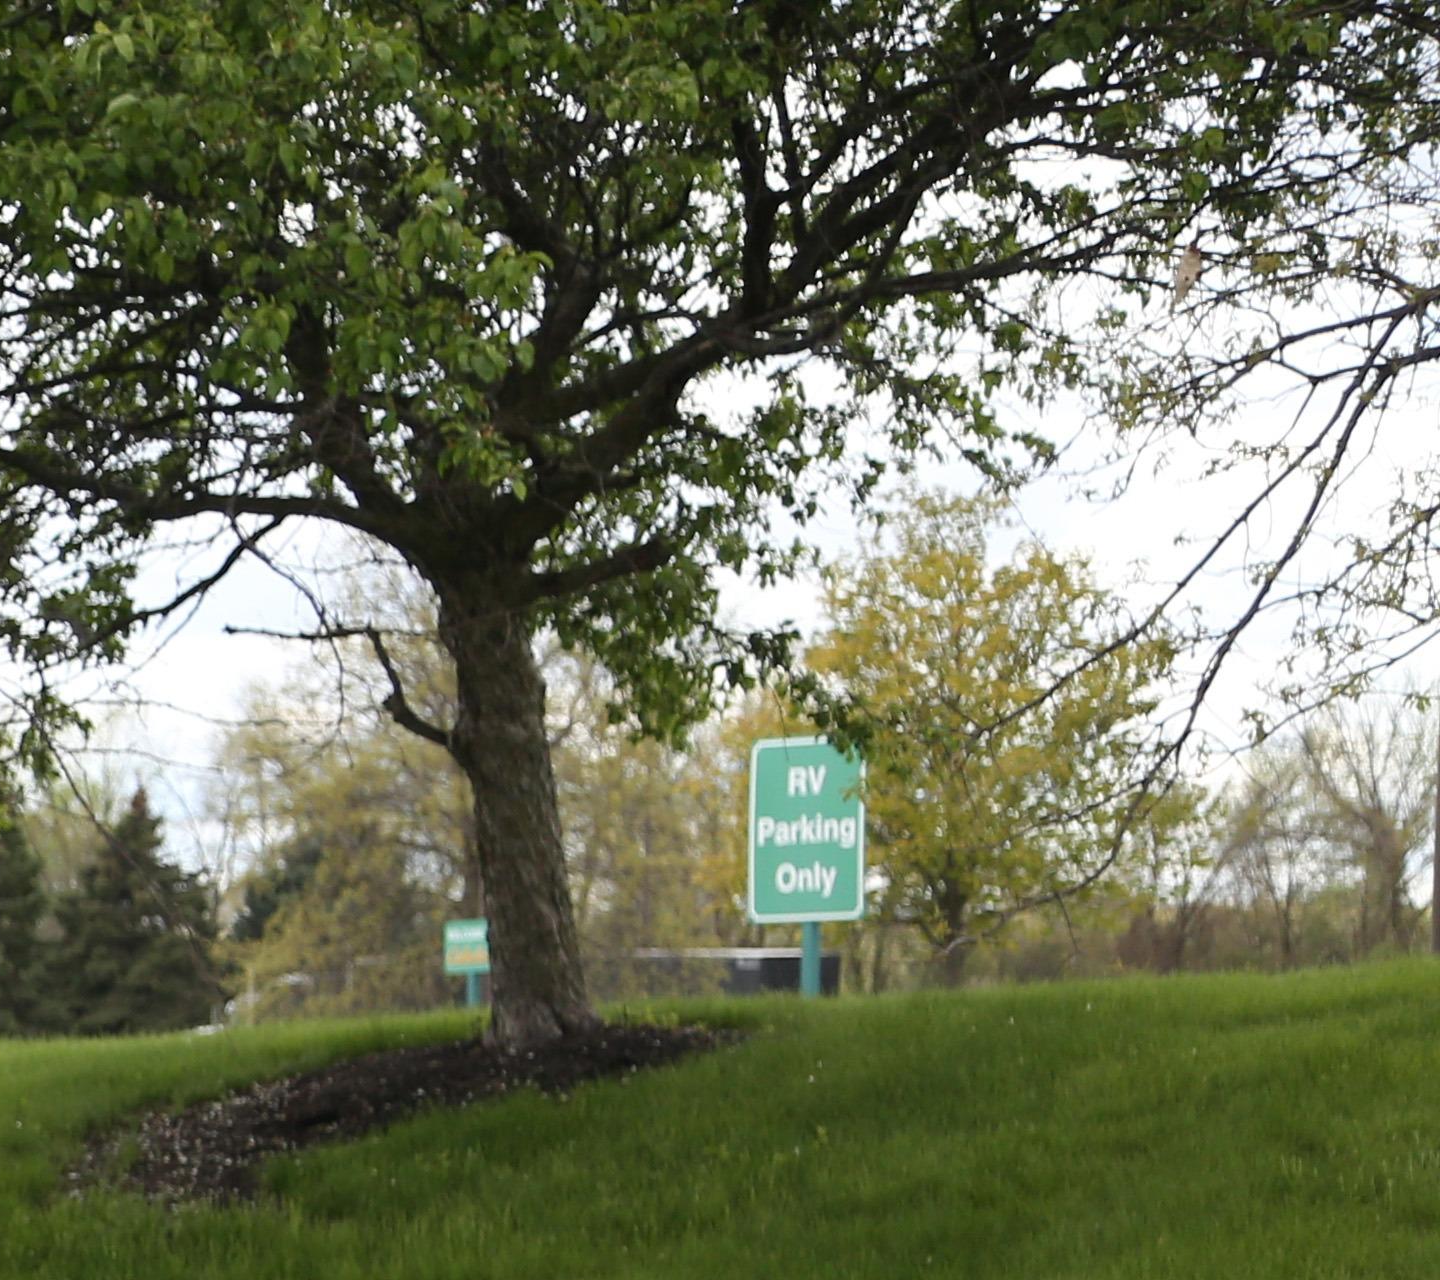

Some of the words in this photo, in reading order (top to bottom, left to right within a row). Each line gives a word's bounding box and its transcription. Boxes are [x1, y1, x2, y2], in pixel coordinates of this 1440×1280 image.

[788, 765, 827, 797] RV
[756, 811, 857, 849] Parking
[775, 860, 838, 898] Only
